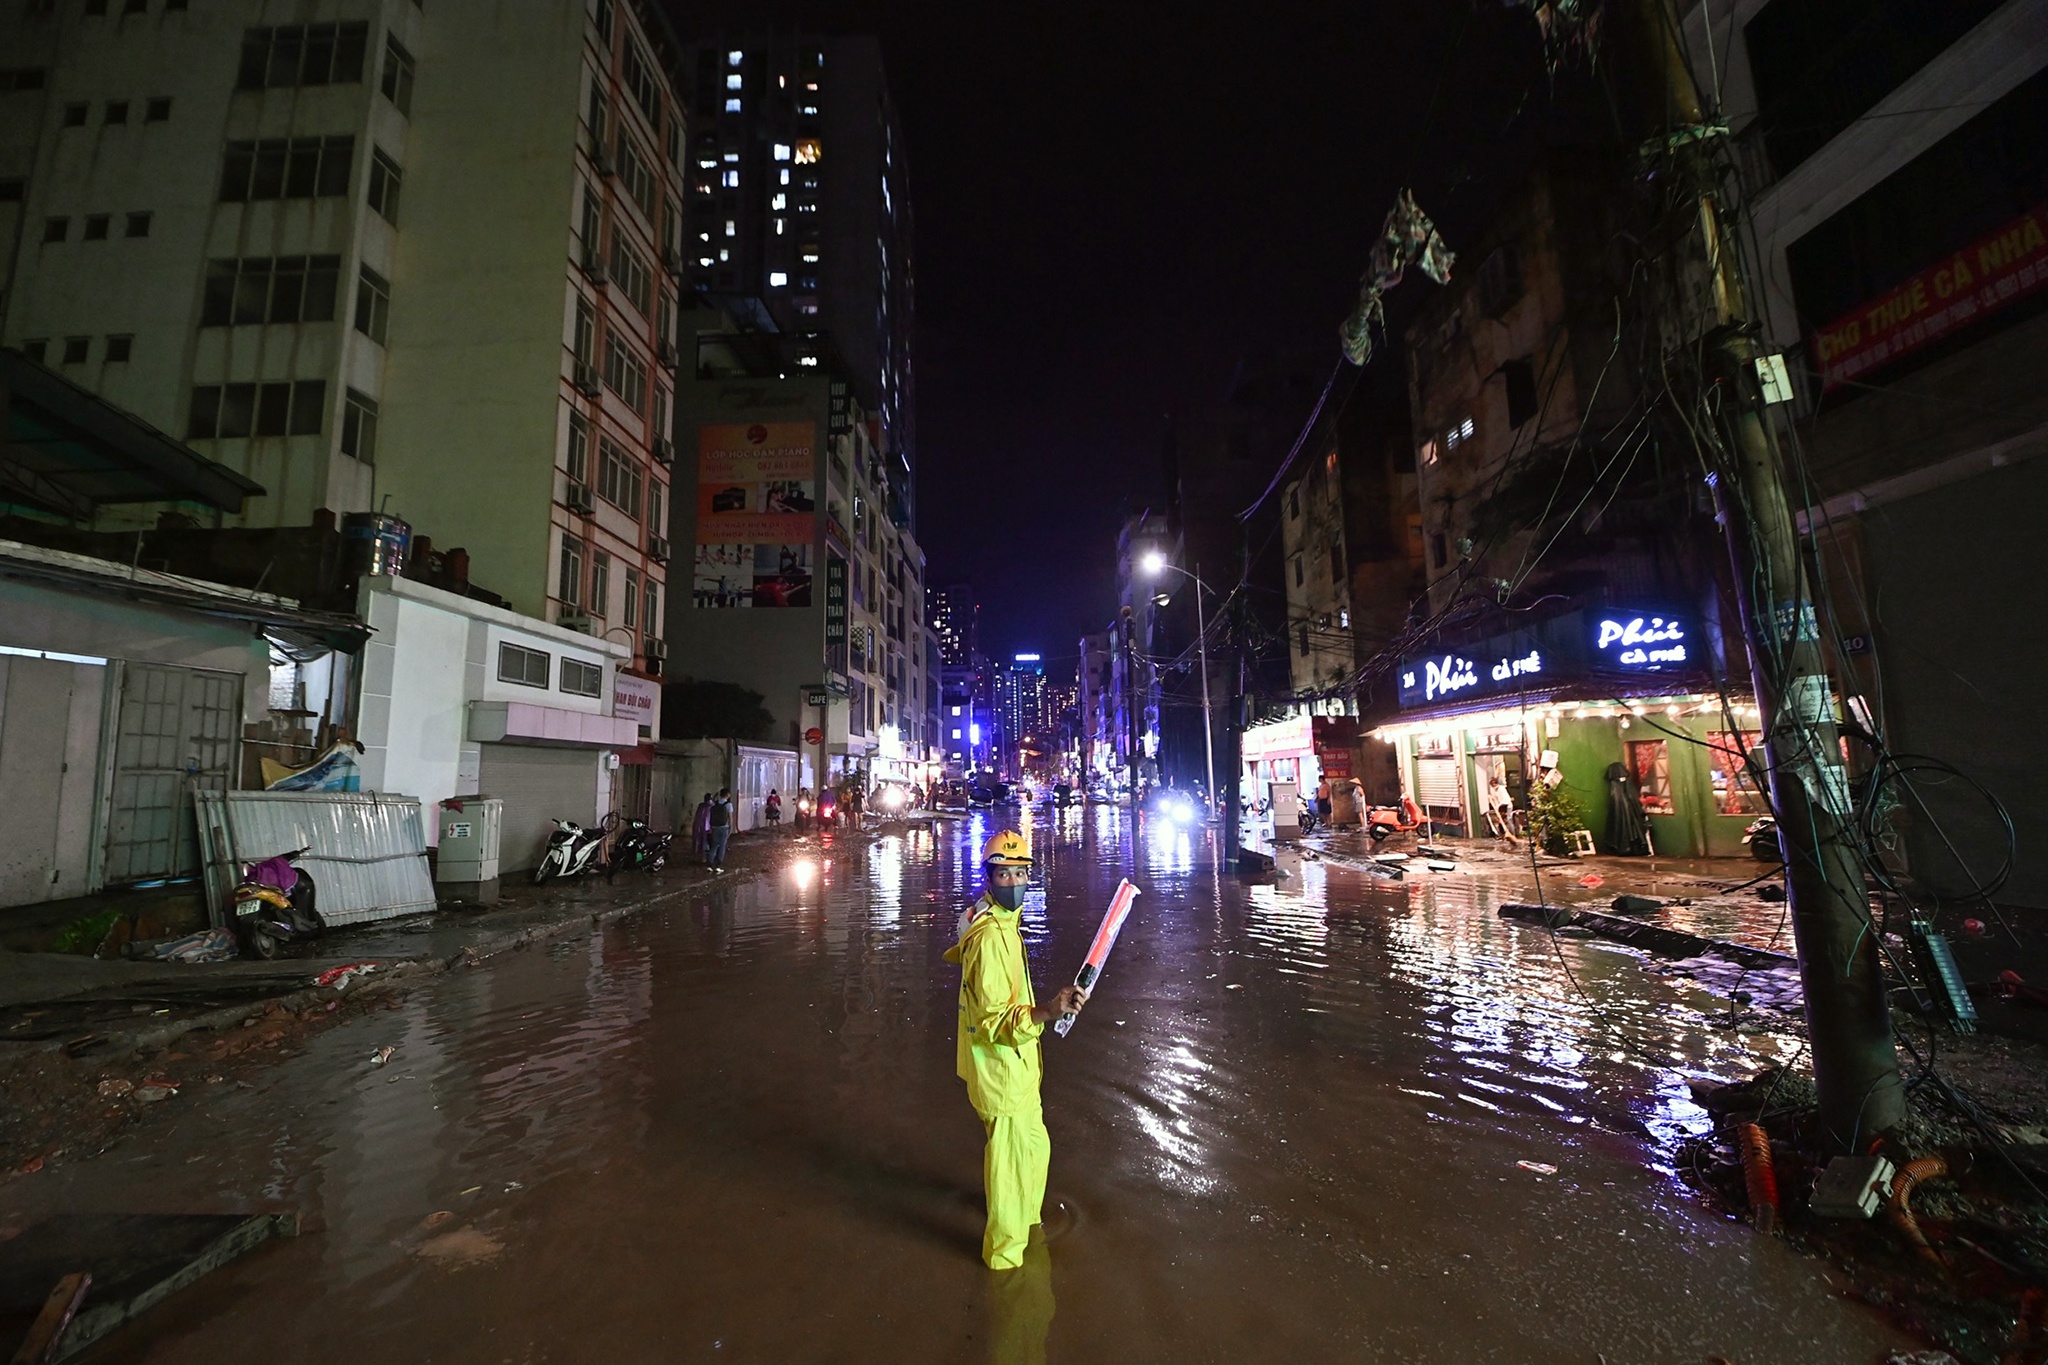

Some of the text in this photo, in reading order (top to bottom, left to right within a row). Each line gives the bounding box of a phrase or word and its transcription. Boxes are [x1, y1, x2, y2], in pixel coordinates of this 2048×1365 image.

[1817, 319, 1861, 361] CHO
[1866, 276, 1930, 337] THUÊ
[1978, 216, 2046, 276] NHÀ
[778, 446, 810, 458] PIANO
[809, 695, 826, 704] CAFE
